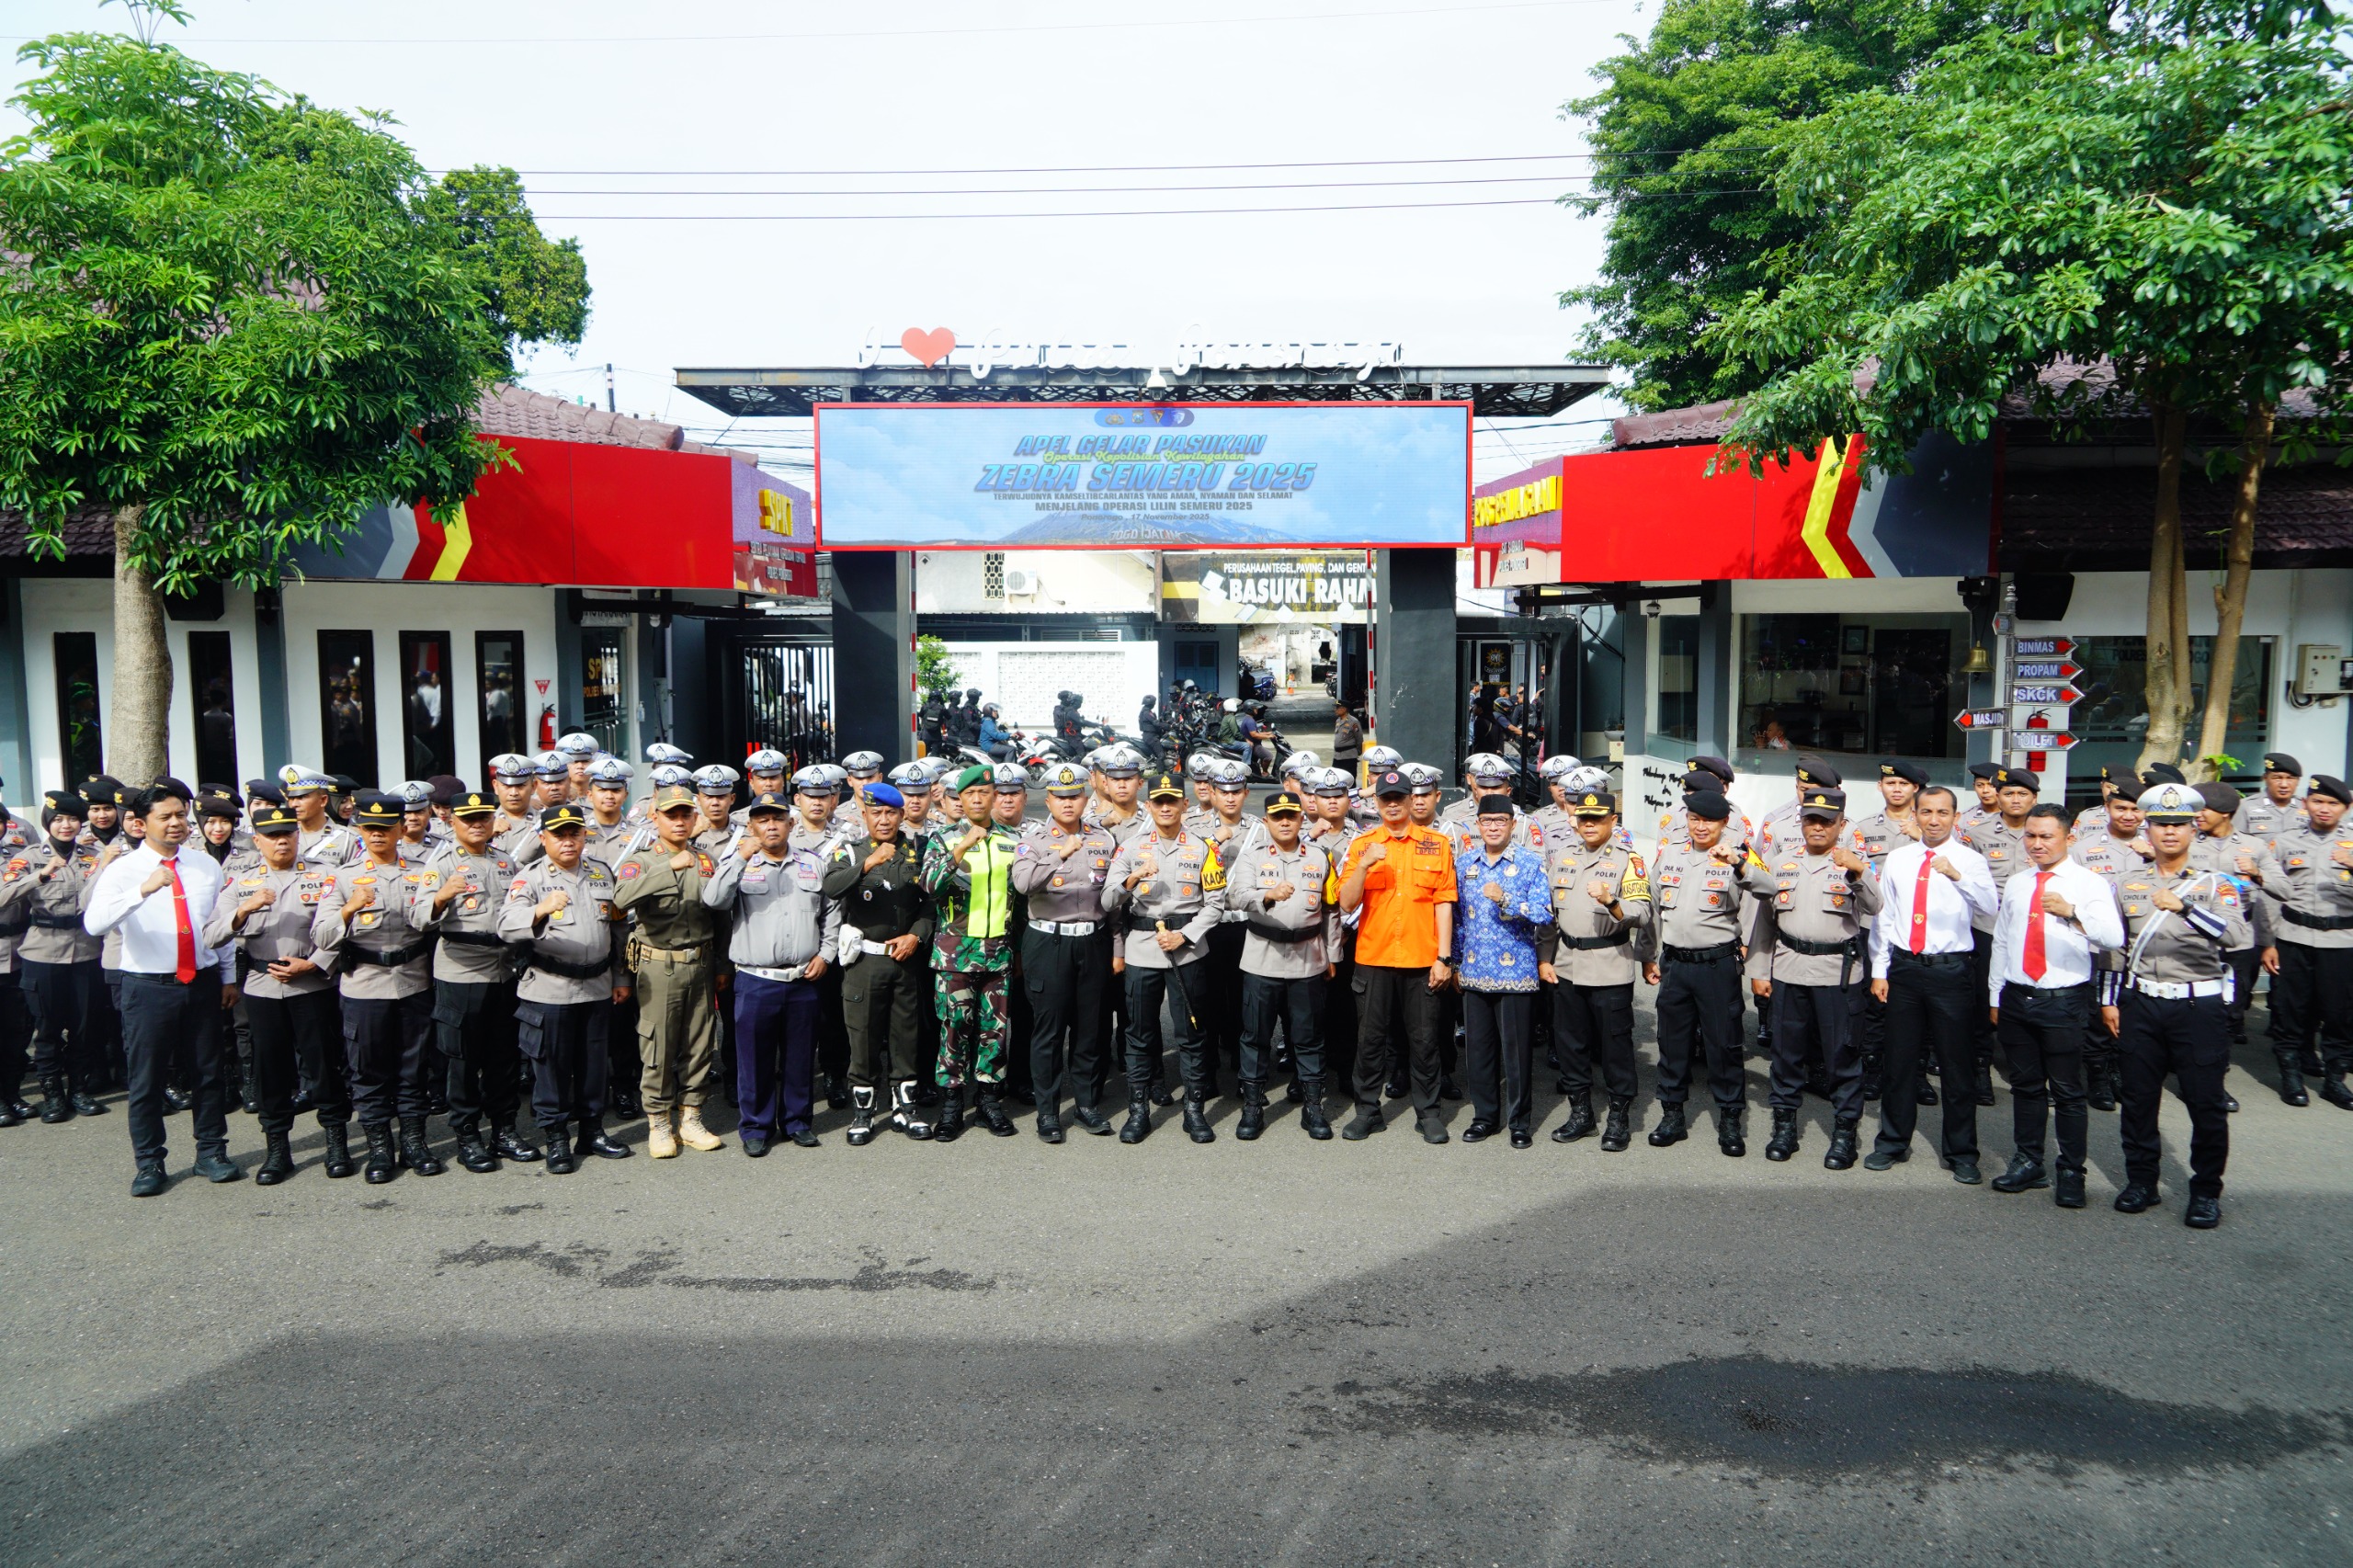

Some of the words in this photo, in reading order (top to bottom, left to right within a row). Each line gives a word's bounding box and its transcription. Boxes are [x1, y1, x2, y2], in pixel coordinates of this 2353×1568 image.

[1014, 435, 1072, 457] APEL
[1076, 435, 1151, 457] GELAR
[1154, 435, 1267, 456] PASUKAN
[1043, 450, 1092, 465] Operasi
[1095, 449, 1161, 465] Kepolisian
[1164, 449, 1245, 464] Kewilayahan
[974, 463, 1081, 492] ZEBRA
[1086, 463, 1226, 492] SEMERU
[1227, 462, 1318, 491] 2025
[994, 493, 1051, 501] TERWUJUDNYA
[1170, 492, 1198, 501] AMAN,
[1199, 492, 1236, 500] NYAMAN
[1035, 502, 1099, 511] MENJELANG
[1103, 502, 1147, 511] OPERASI
[1151, 502, 1176, 511] LILIN
[1179, 501, 1222, 511] SEMERU
[1225, 501, 1253, 510] 2025
[1142, 513, 1188, 521] November
[1189, 513, 1210, 521] 2025
[1223, 562, 1272, 574] PERUSAHAAN
[1328, 562, 1345, 574] DAN
[1229, 578, 1307, 604] BASUKI
[2018, 641, 2054, 653] BINMAS
[2018, 665, 2058, 676] PROPAM
[2017, 688, 2057, 701] SKCK
[1972, 713, 2002, 725] MASJID
[2016, 734, 2055, 746] TOILET
[1595, 870, 1617, 879] POLRI
